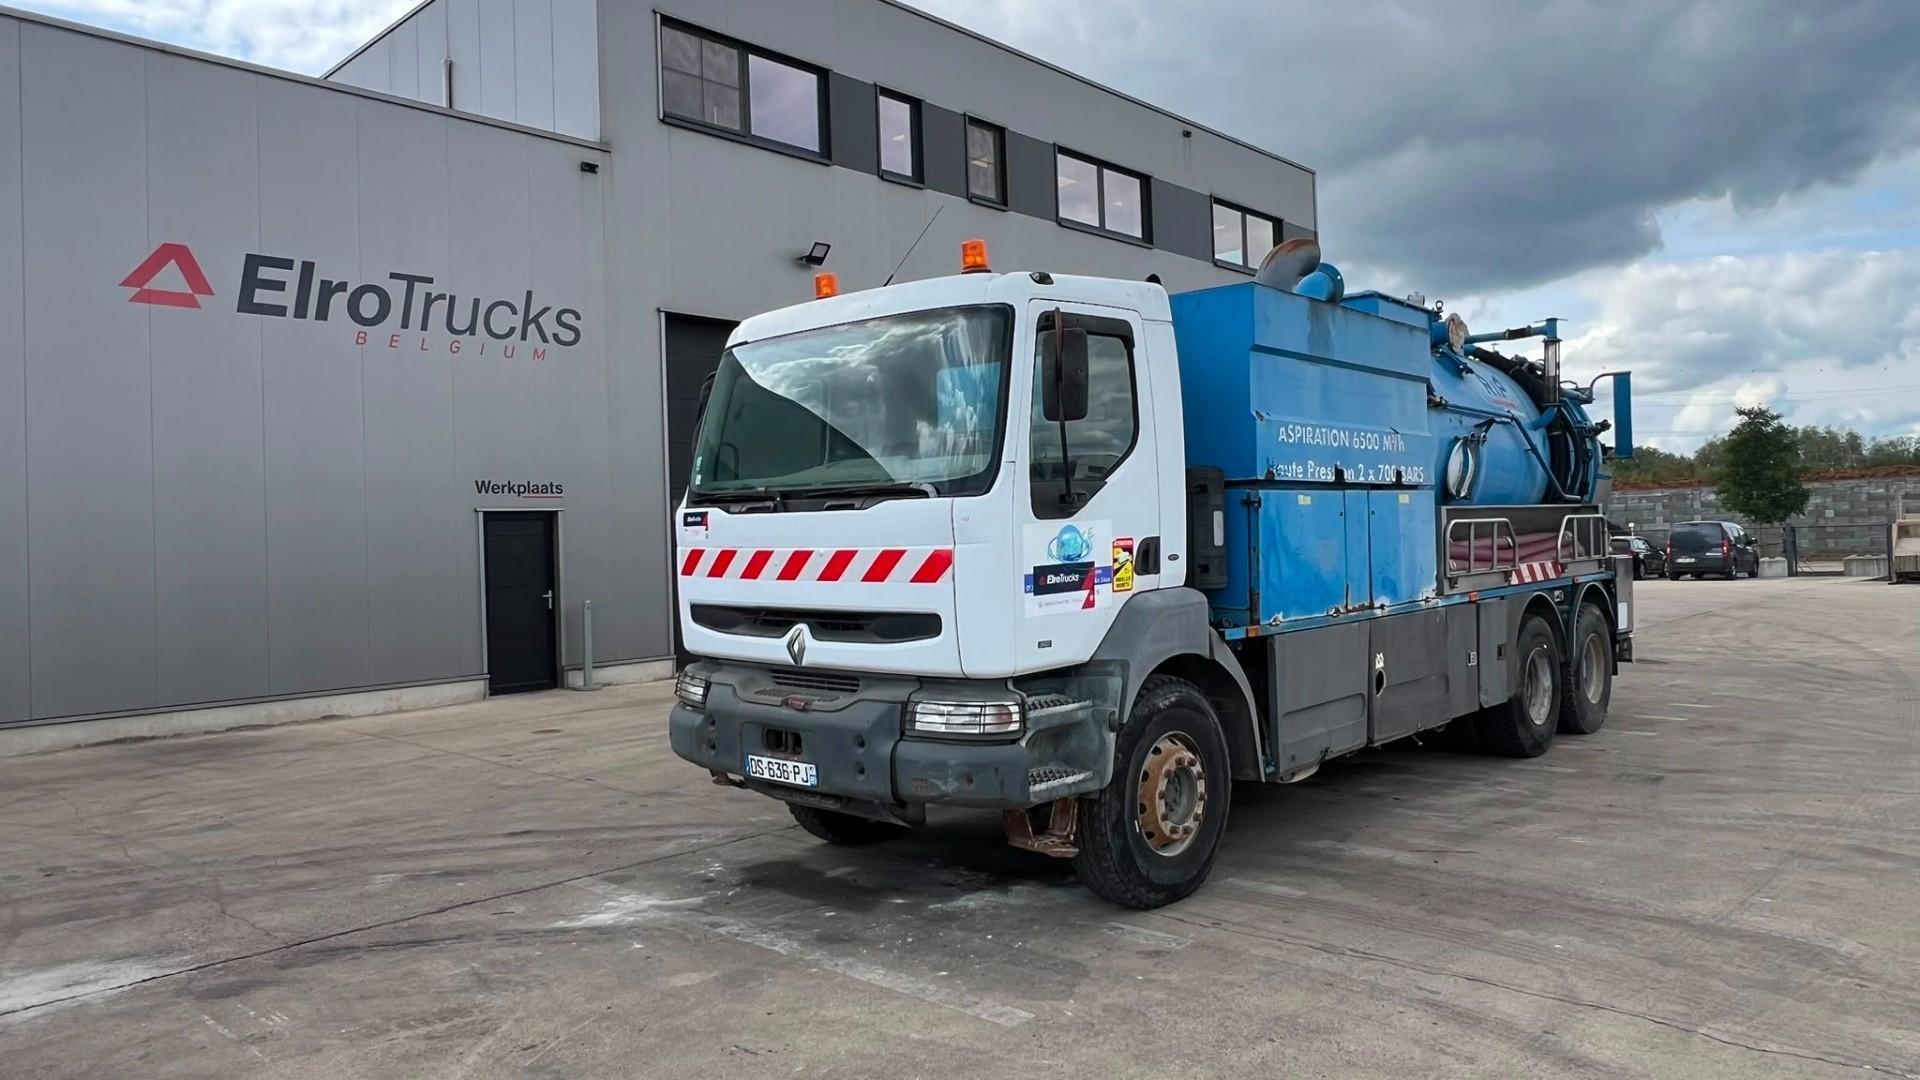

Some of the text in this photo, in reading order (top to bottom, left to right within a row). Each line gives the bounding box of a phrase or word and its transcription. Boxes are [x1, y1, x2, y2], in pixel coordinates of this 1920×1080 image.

[236, 252, 583, 347] ElroTrucks
[355, 331, 548, 362] BELGIUM
[1278, 424, 1349, 447] ASPIRATION
[1352, 431, 1380, 451] 6500
[1308, 460, 1355, 481] Preson
[1358, 463, 1365, 481] 2
[1367, 469, 1375, 482] x
[1377, 464, 1397, 482] 700
[474, 479, 564, 497] Werkplaats
[750, 757, 809, 783] DS-636-PJ
